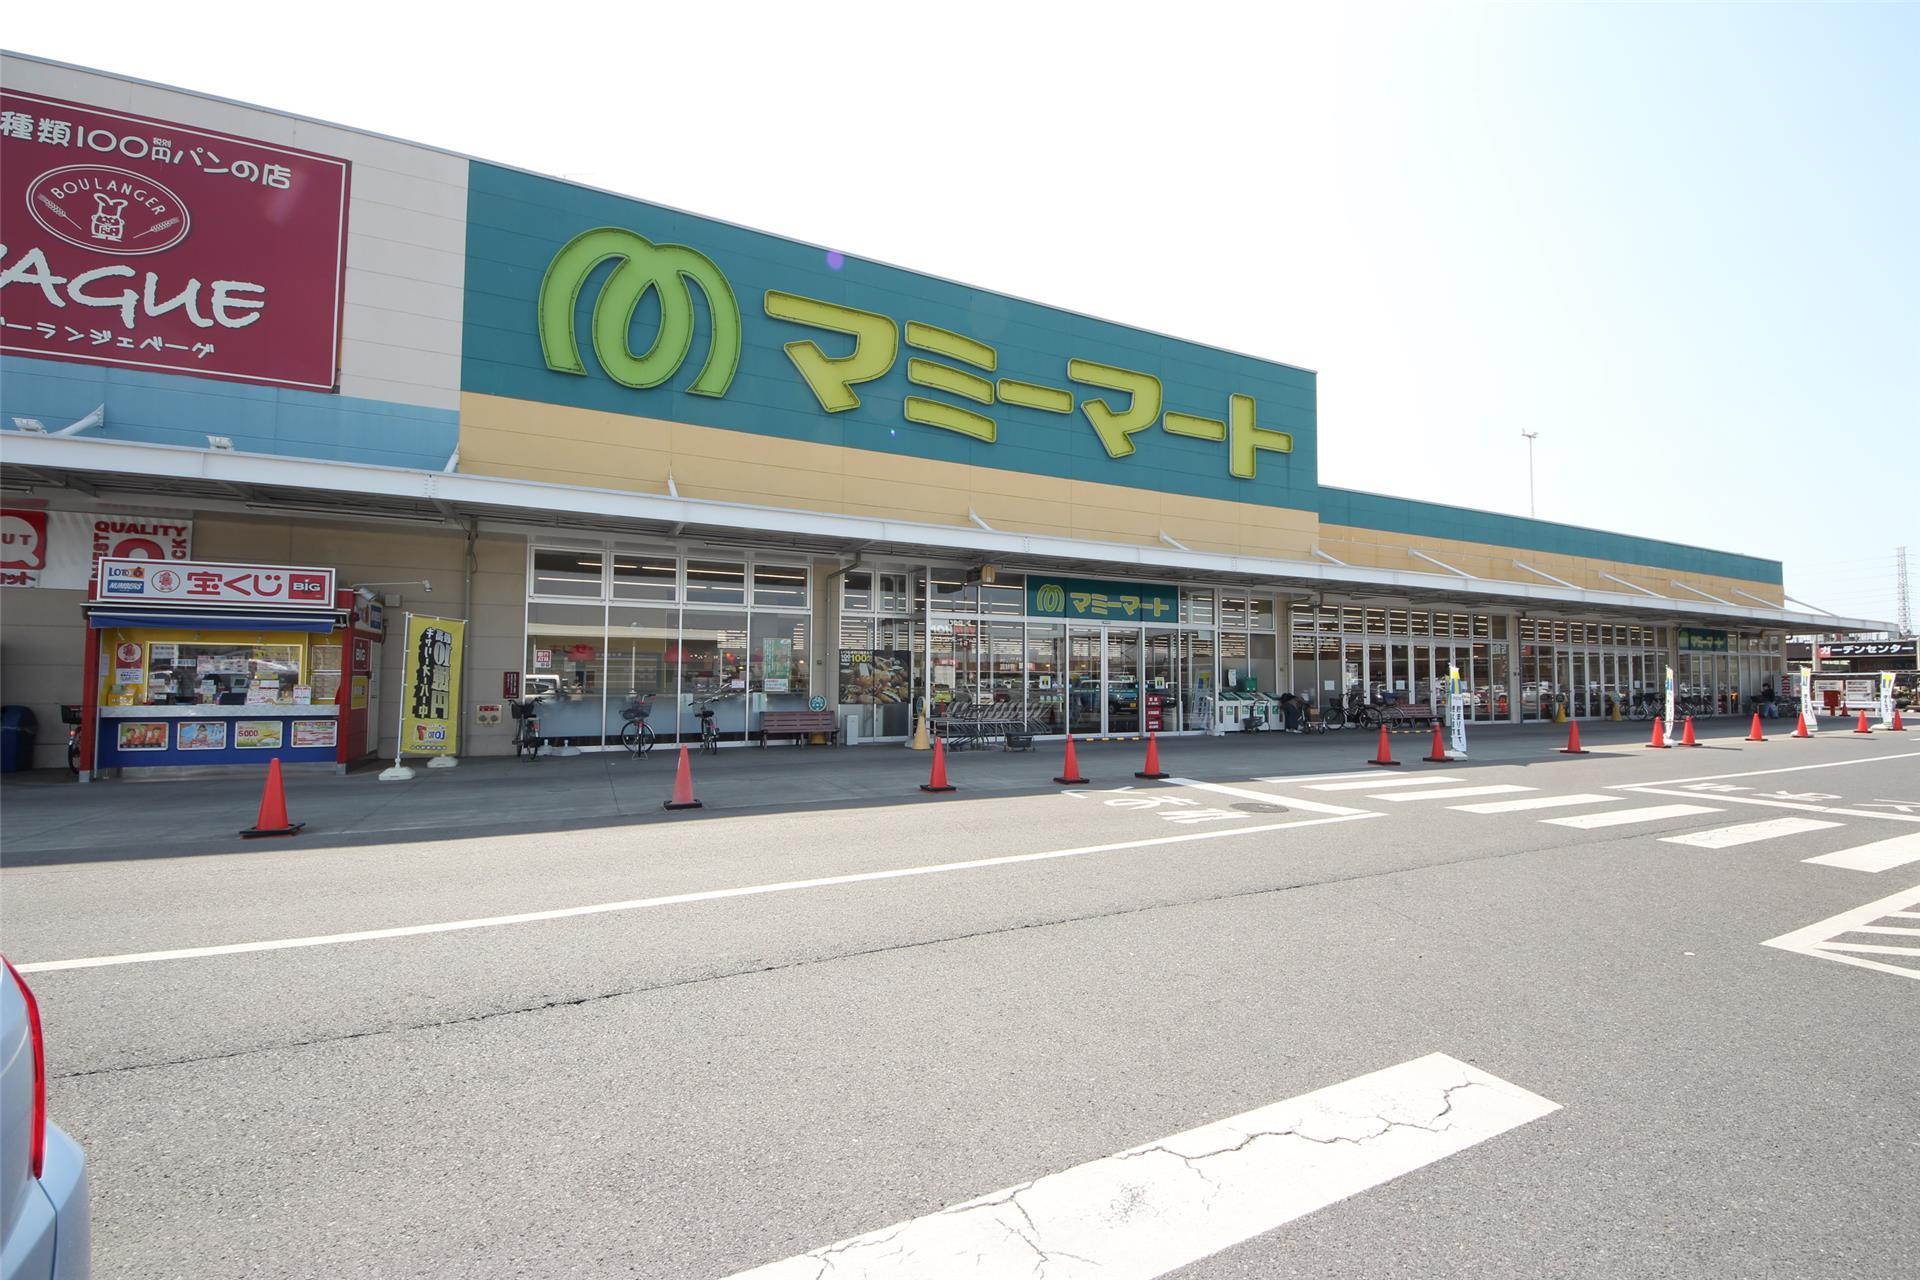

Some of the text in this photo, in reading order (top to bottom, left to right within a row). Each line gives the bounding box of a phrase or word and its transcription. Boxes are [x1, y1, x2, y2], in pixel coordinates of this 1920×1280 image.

[50, 177, 166, 215] BOULANGER
[0, 244, 265, 329] AGUE
[0, 316, 214, 359] ーランジェベーグ
[764, 289, 1293, 479] マミーマート
[94, 521, 188, 537] QUALITY
[187, 572, 282, 597] 宝くじ
[1070, 592, 1169, 617] マミーマート
[1820, 644, 1914, 655] ガーデンセンター
